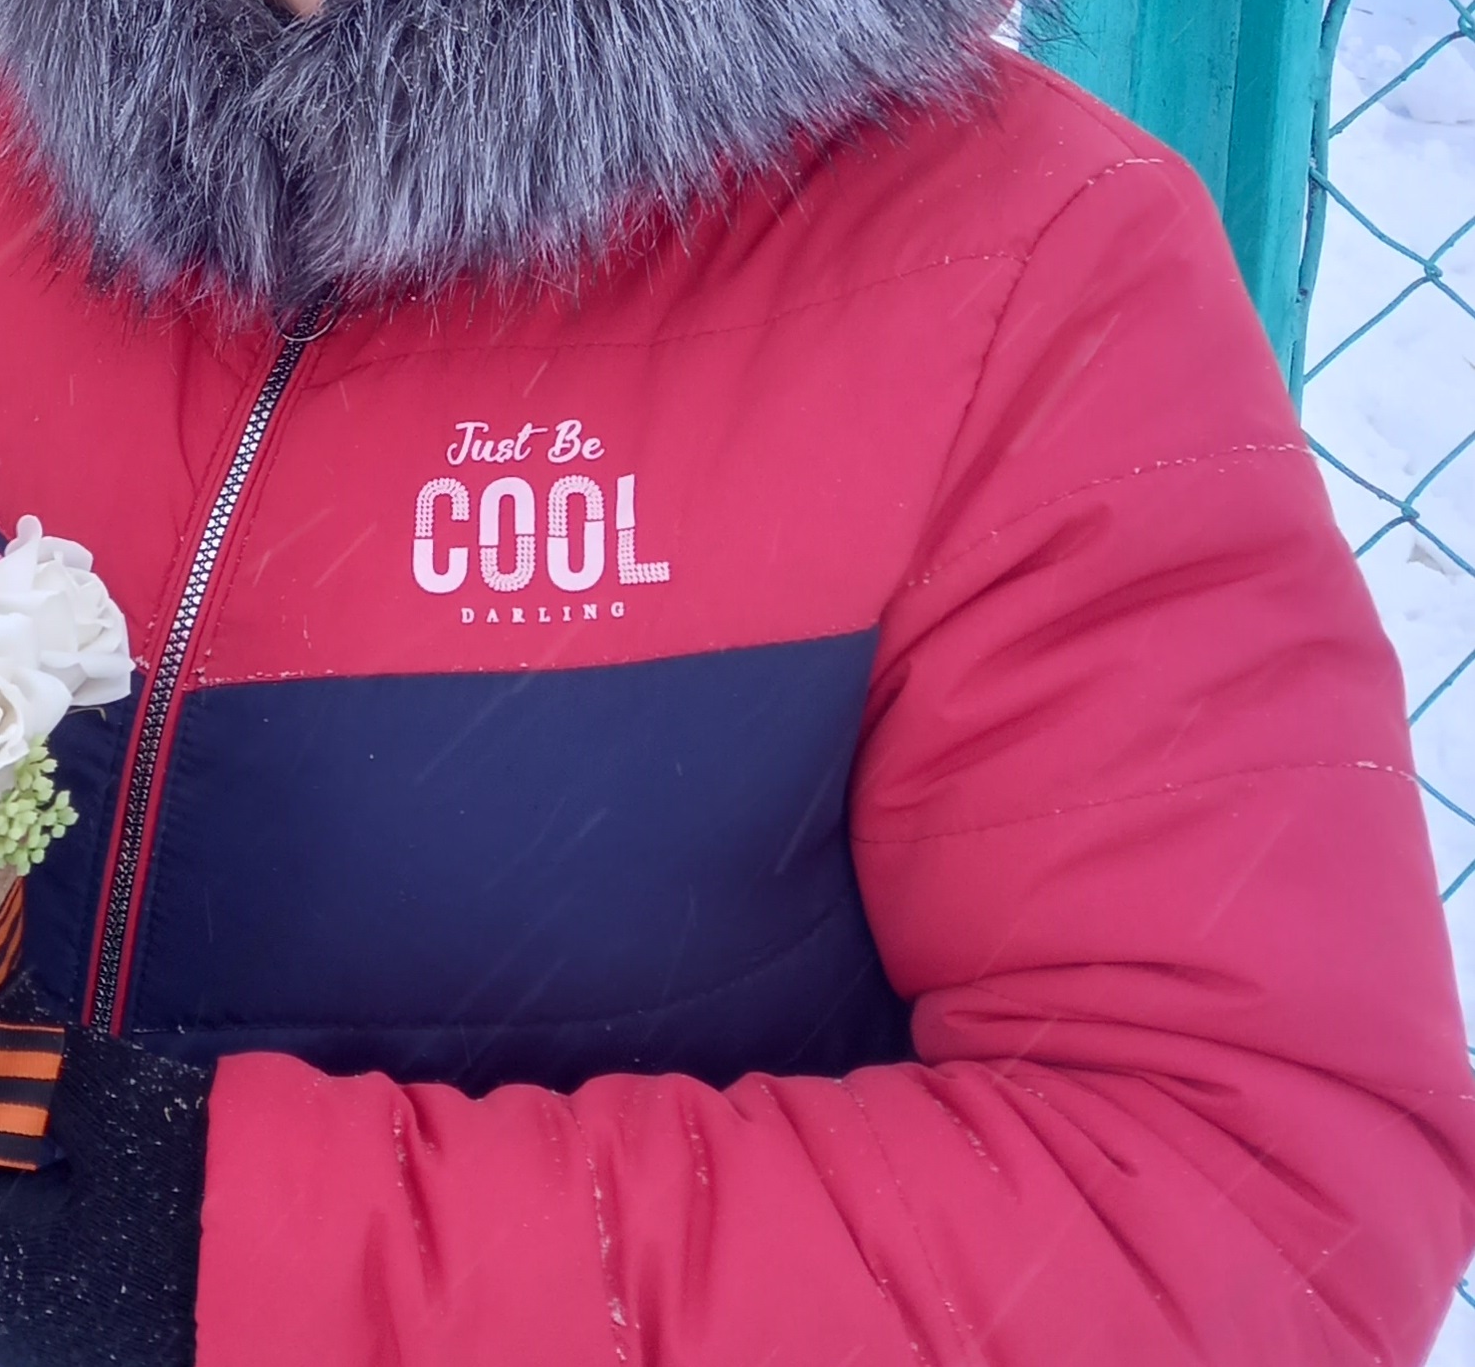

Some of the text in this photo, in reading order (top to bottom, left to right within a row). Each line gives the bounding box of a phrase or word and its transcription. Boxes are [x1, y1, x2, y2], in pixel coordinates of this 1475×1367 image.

[446, 419, 605, 465] Just Be
[412, 473, 670, 594] COOL
[461, 601, 625, 624] DARLING
